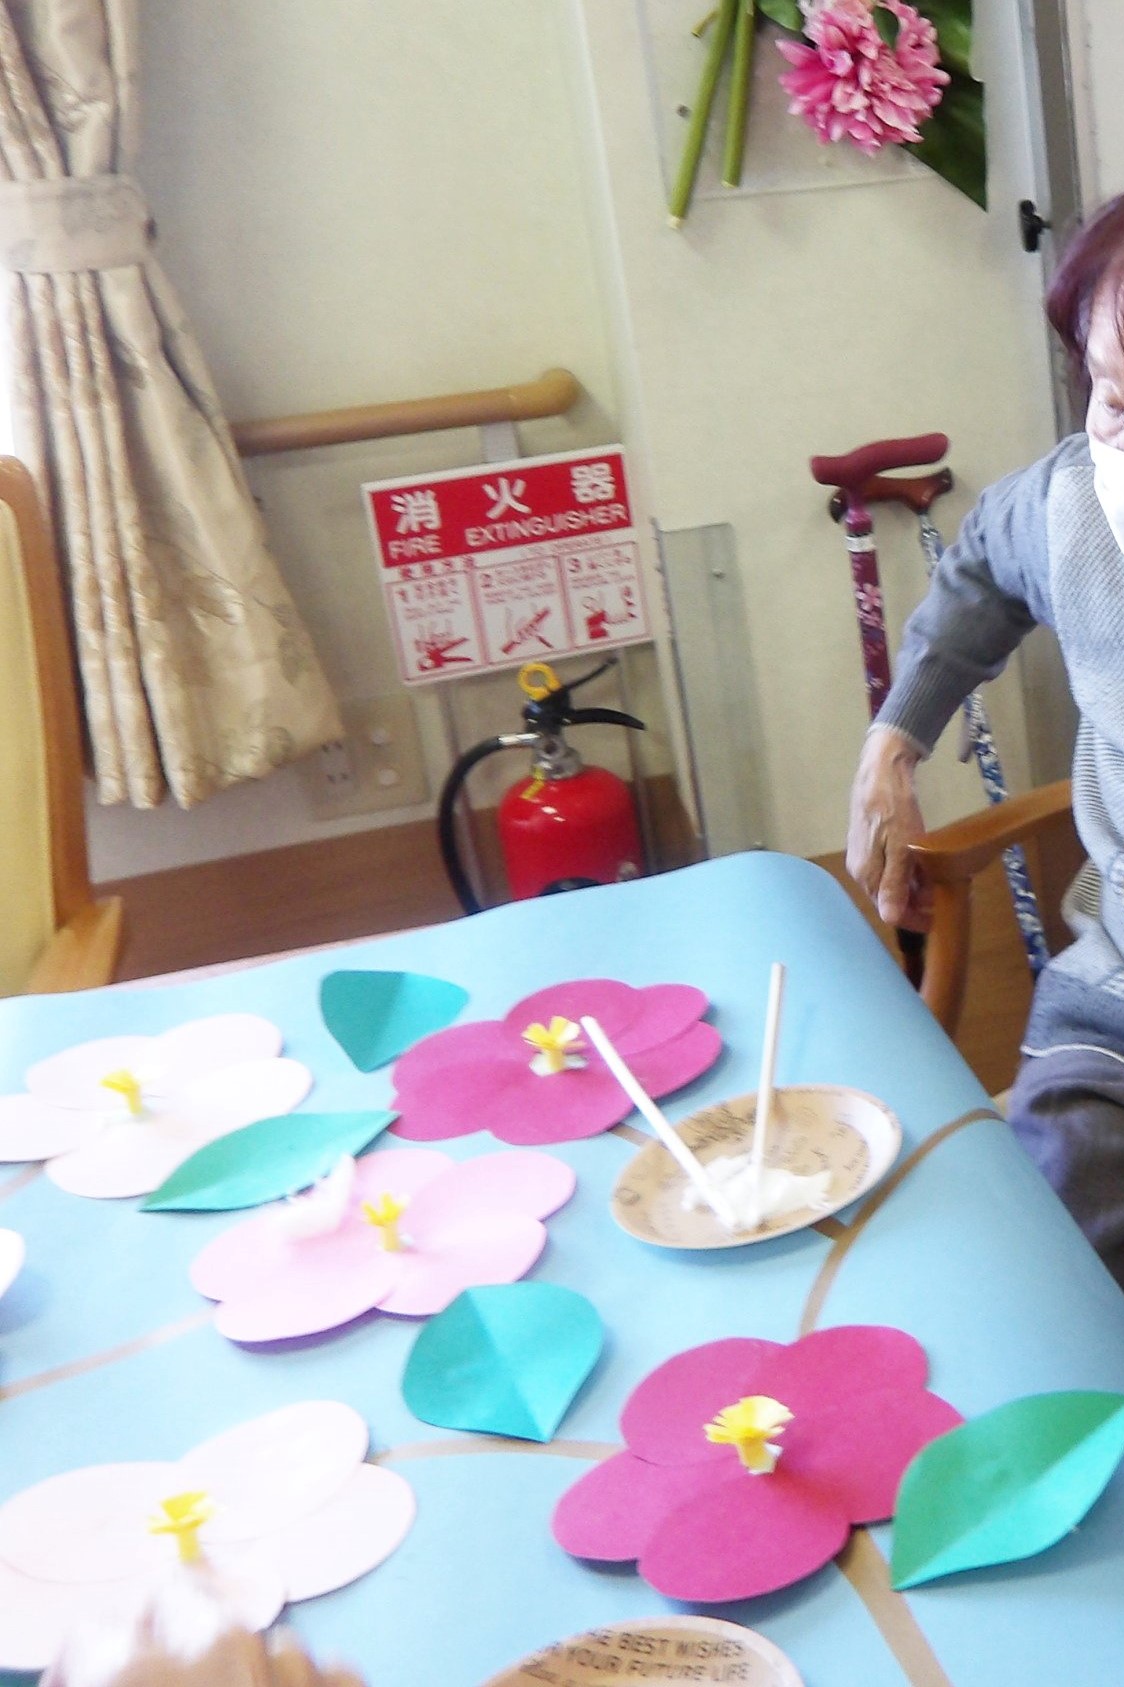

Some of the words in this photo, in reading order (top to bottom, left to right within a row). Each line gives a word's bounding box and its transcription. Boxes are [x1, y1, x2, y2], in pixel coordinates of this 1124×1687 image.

[390, 462, 615, 534] 消火器
[387, 534, 442, 560] FIRE
[464, 502, 628, 547] EXTINGUISHER
[567, 1646, 623, 1674] YOUR
[626, 1659, 705, 1681] FUTURE
[710, 1661, 751, 1682] LIFE
[618, 1632, 670, 1655] BEST
[675, 1638, 746, 1659] WISHES
